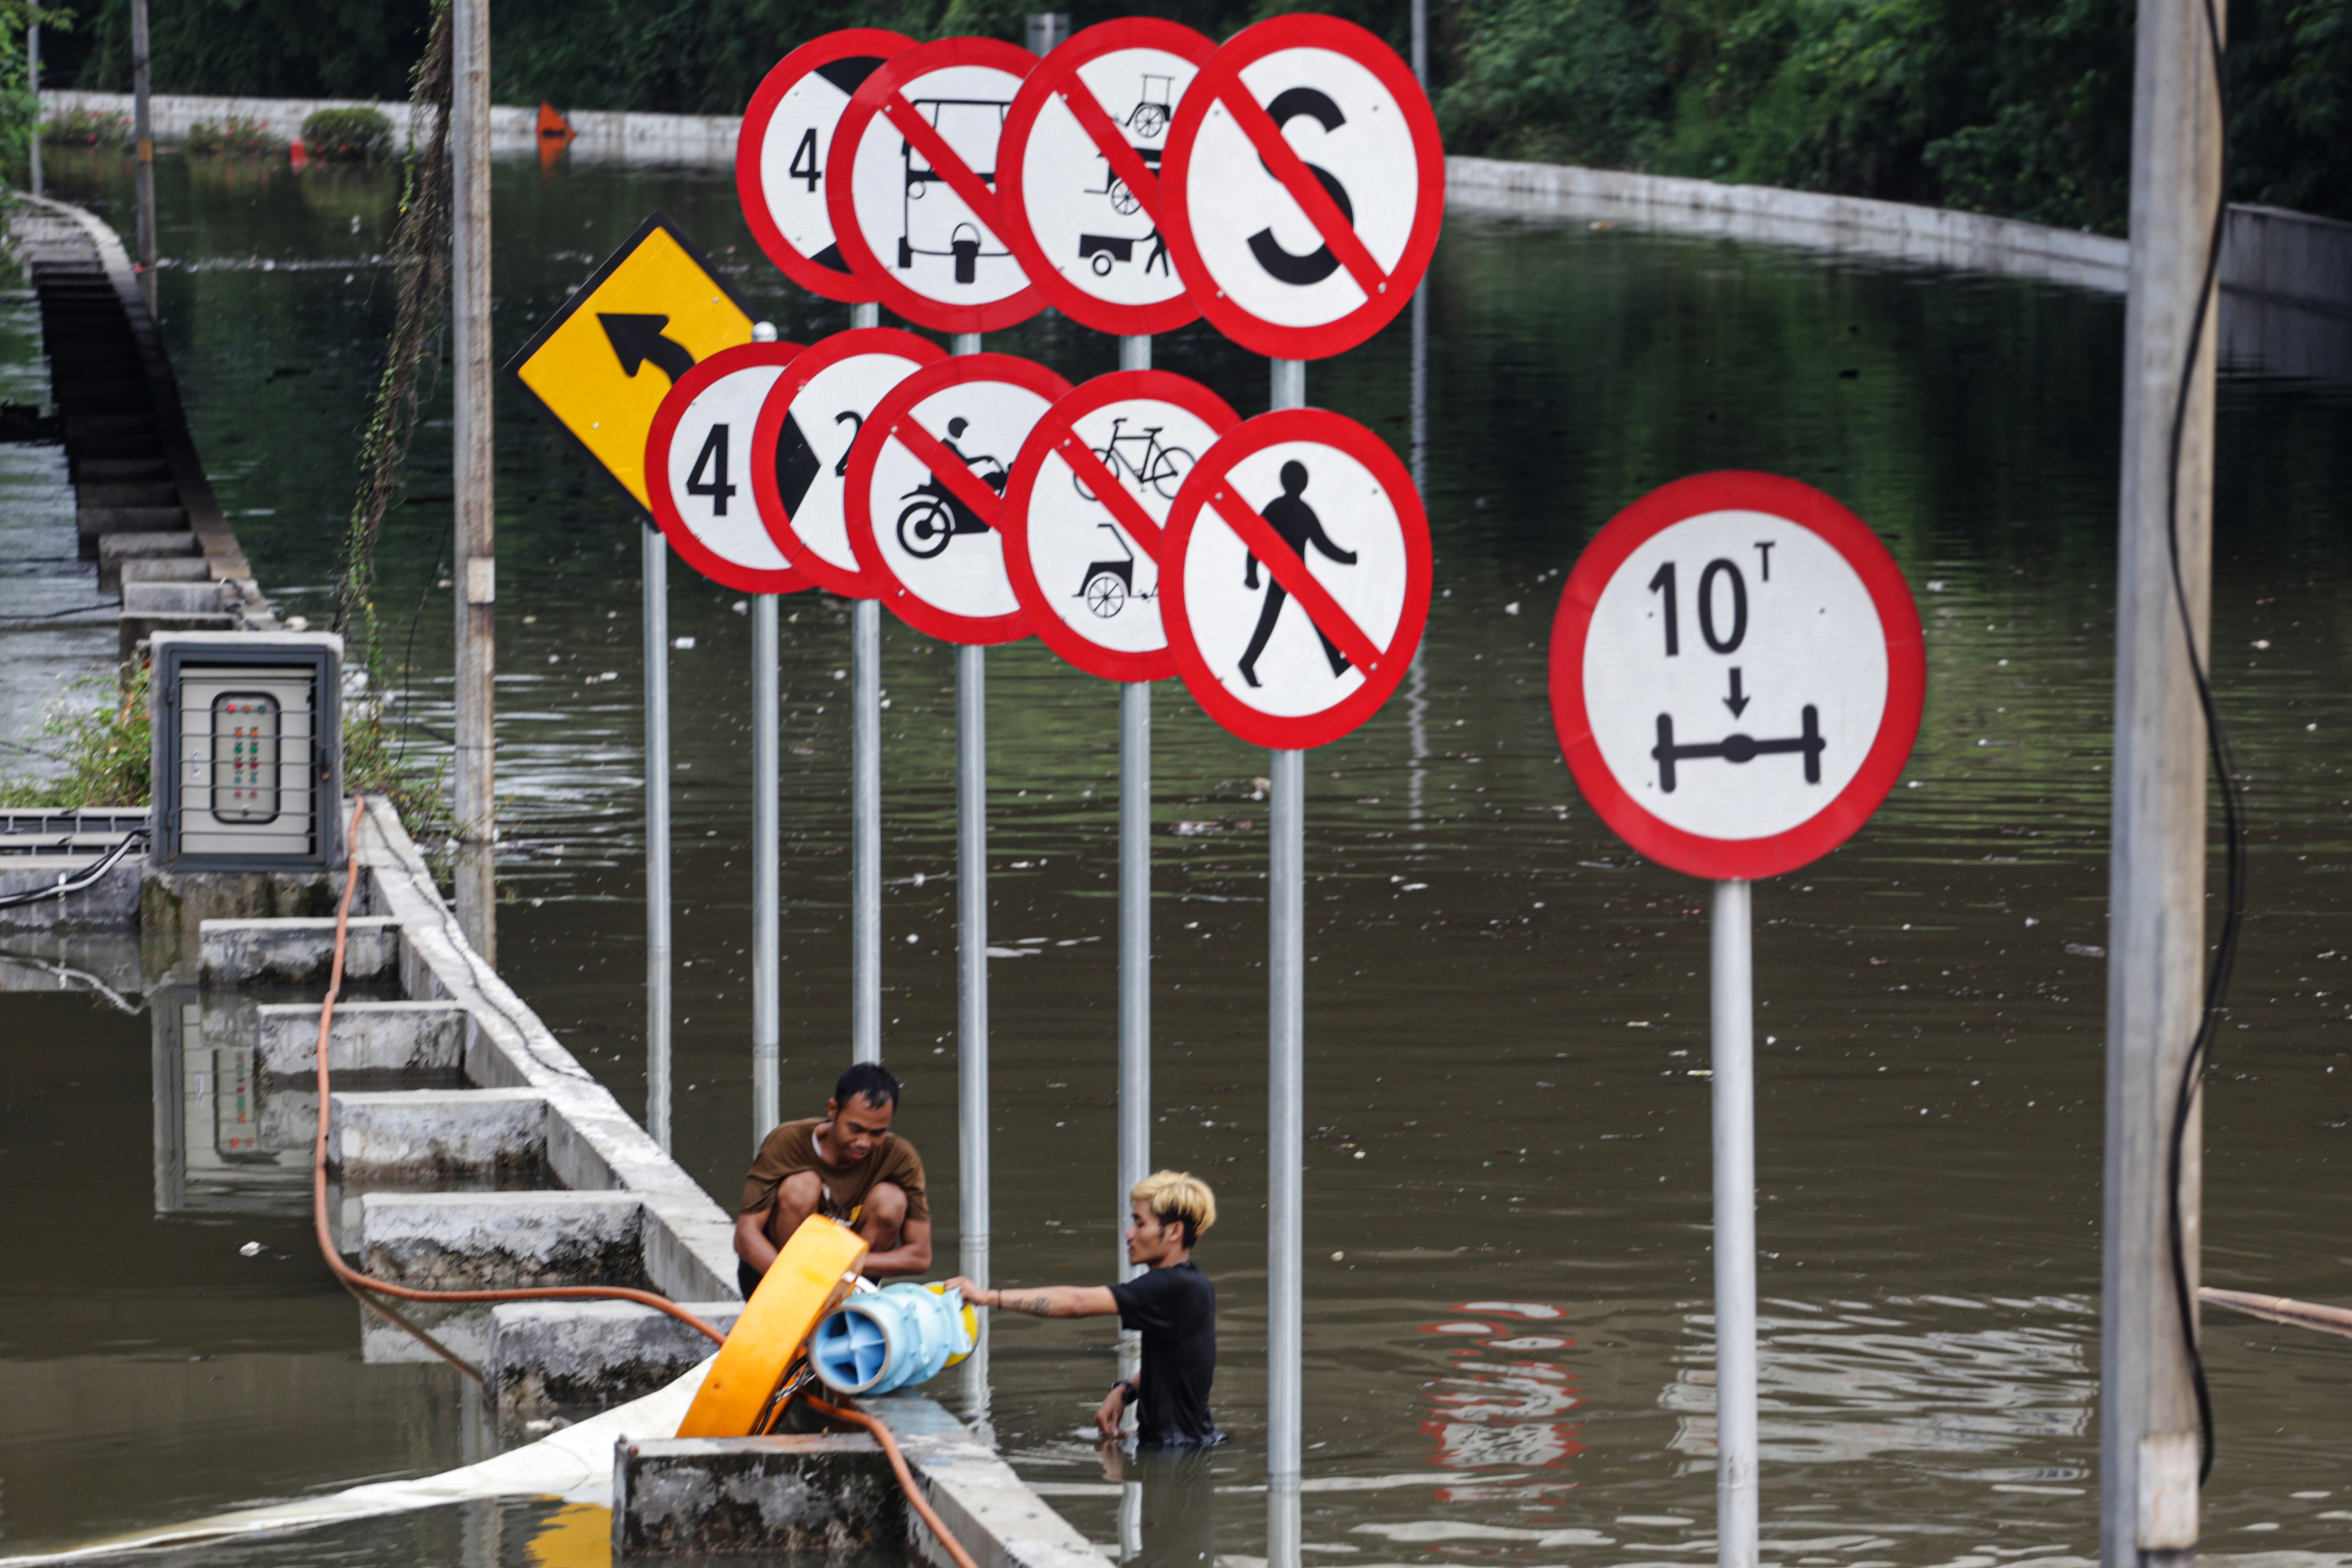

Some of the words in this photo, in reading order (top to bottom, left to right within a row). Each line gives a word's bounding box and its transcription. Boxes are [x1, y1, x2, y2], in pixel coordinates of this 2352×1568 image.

[790, 128, 822, 192] 4
[1247, 87, 1354, 286] S
[686, 423, 736, 517] 4
